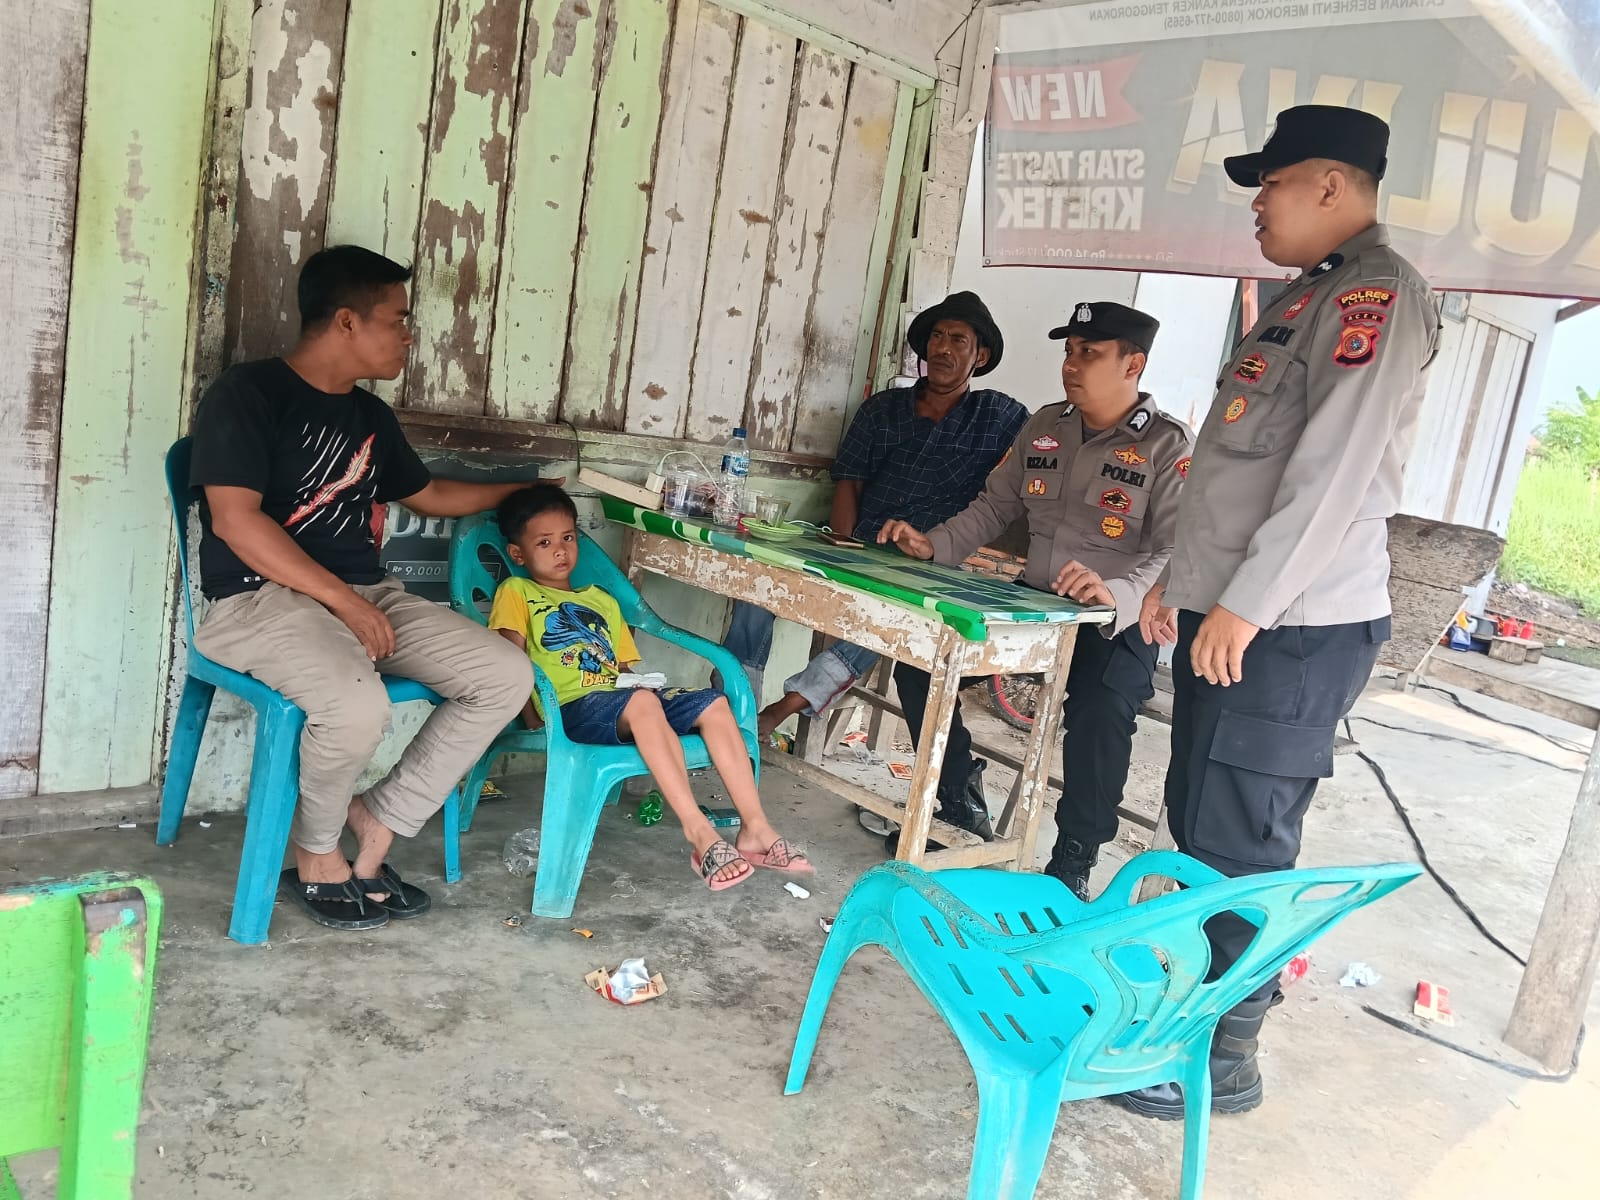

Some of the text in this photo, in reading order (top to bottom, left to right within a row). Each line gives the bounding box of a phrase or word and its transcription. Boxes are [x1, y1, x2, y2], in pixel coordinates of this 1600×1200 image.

[1341, 290, 1389, 304] POLRES
[1348, 313, 1378, 321] ACEH
[1101, 463, 1147, 487] POLRI
